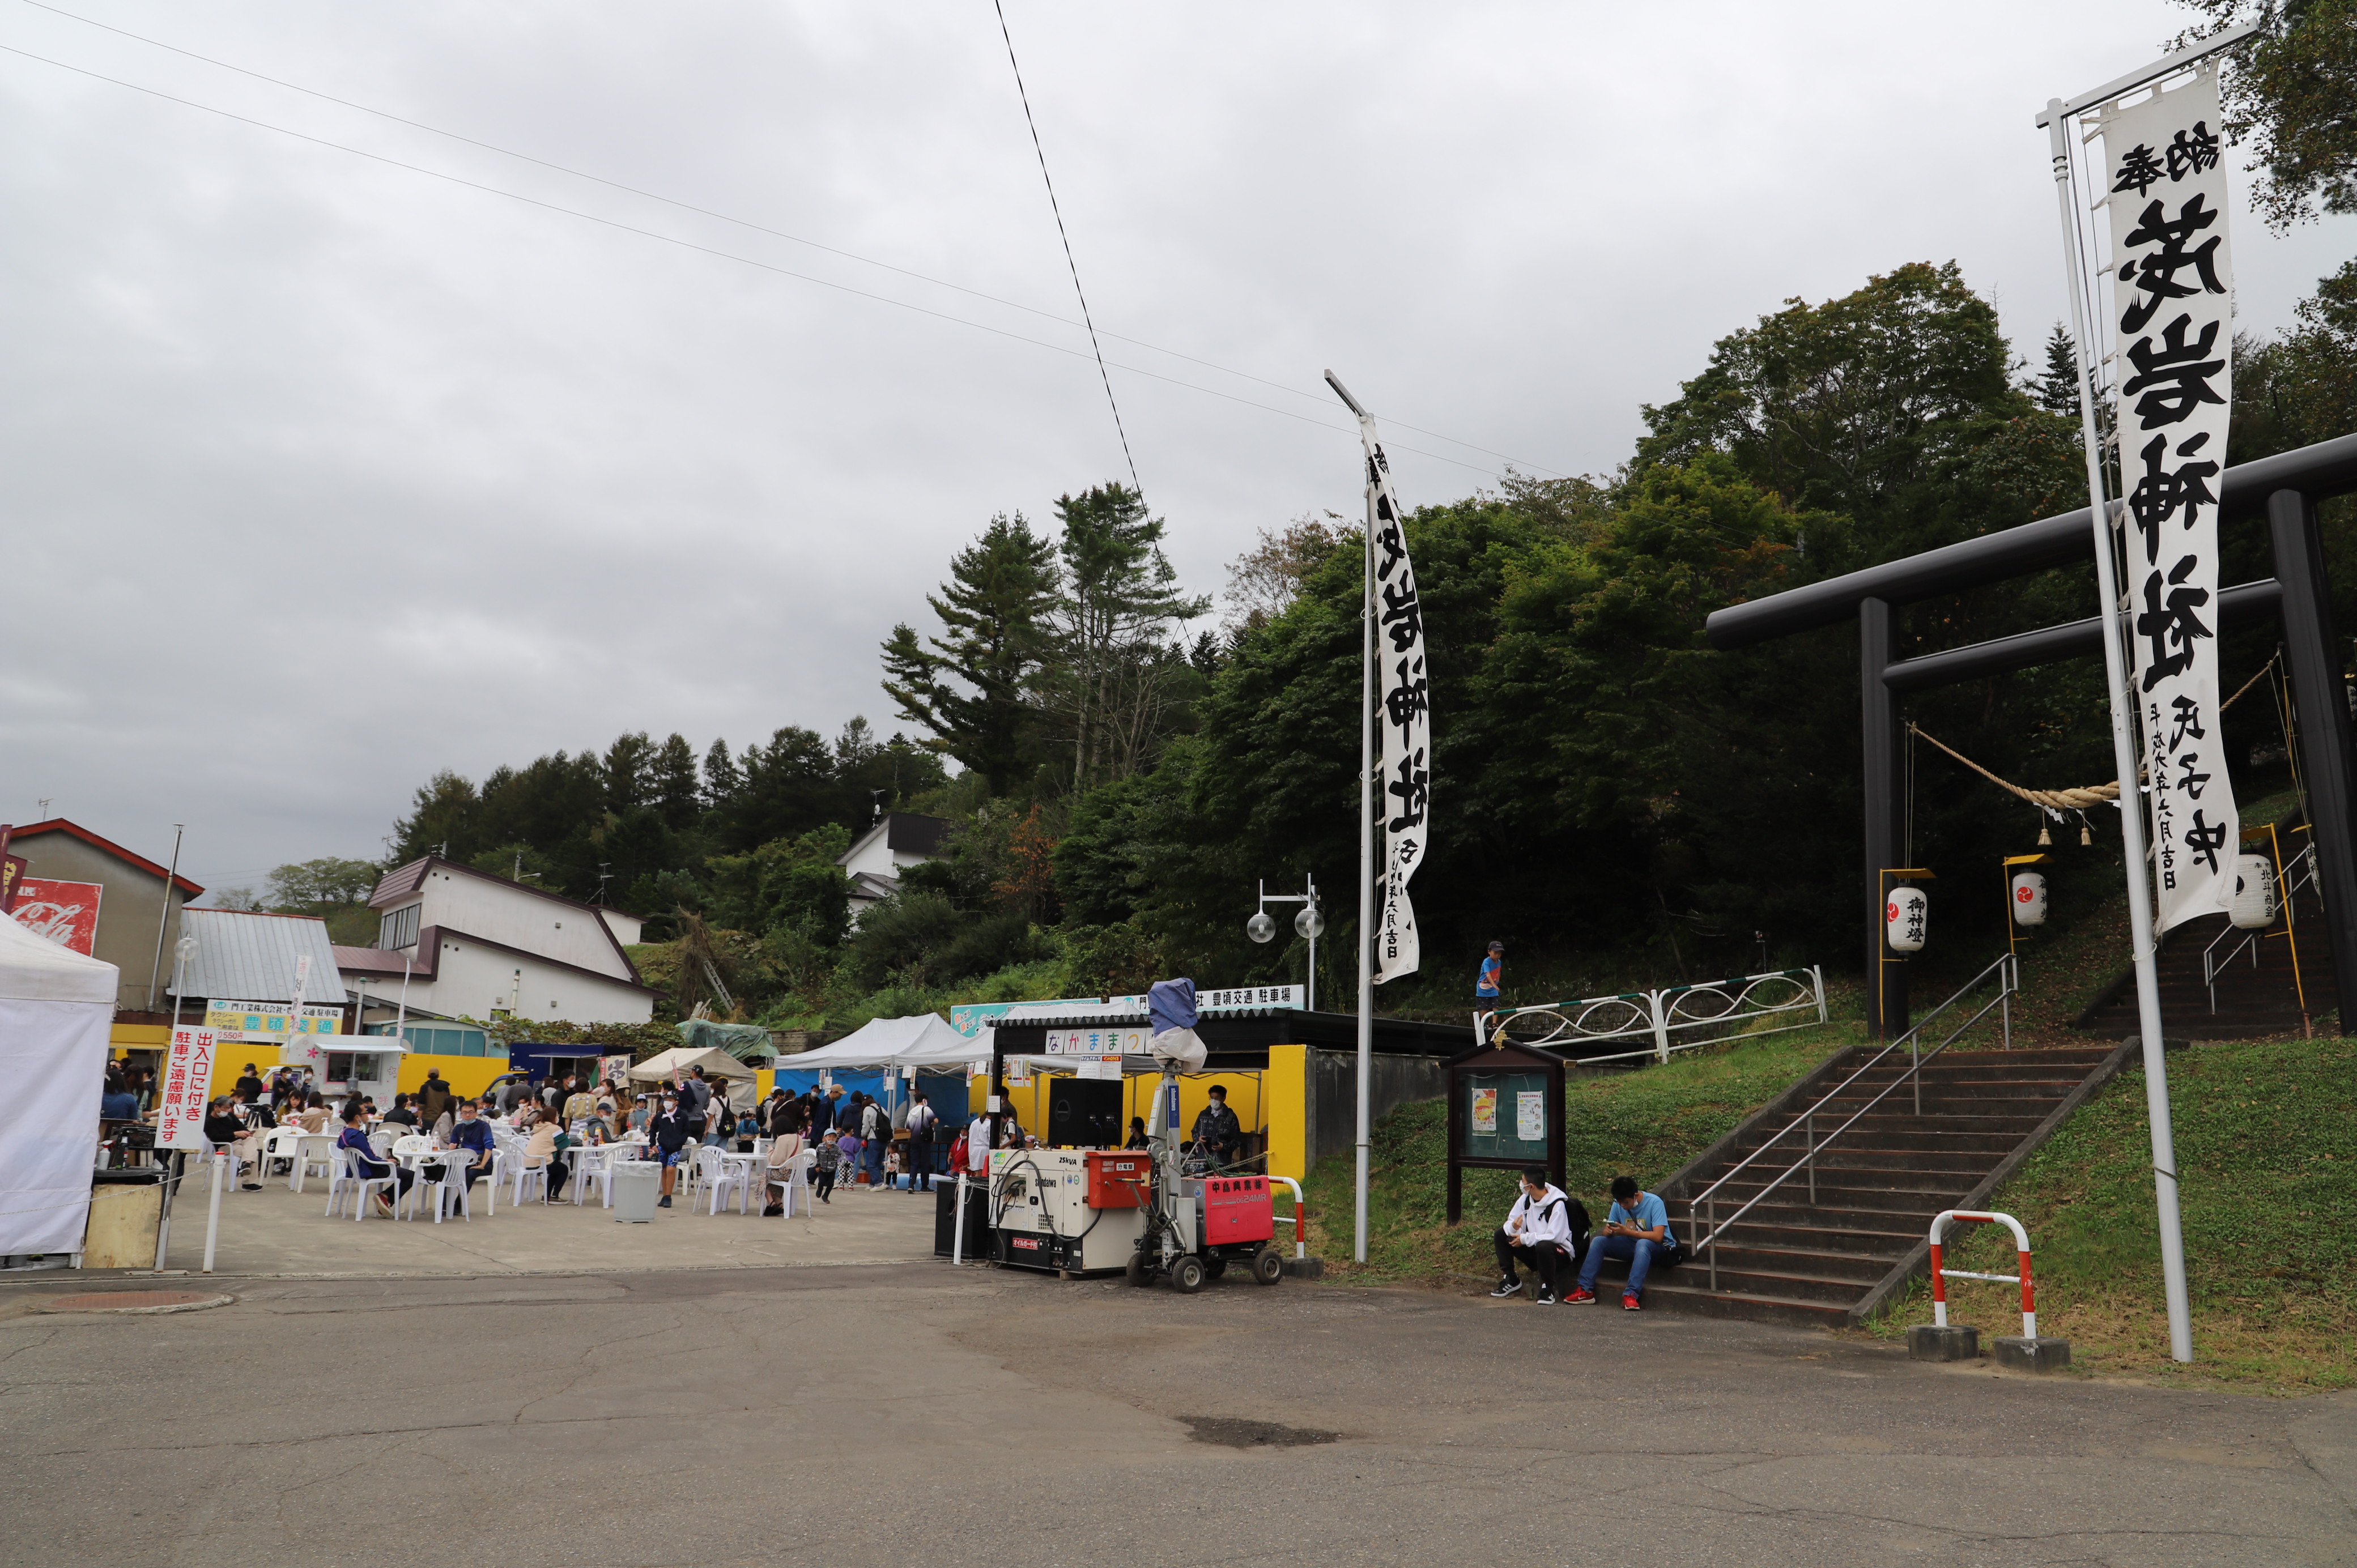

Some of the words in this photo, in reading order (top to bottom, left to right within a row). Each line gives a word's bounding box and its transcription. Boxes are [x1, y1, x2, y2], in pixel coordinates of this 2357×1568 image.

[2261, 870, 2273, 917] 北斗商会
[1212, 990, 1253, 1006] 豊頃交通
[1259, 987, 1291, 1003] 駐車場
[1049, 1032, 1154, 1051] なかままつ
[186, 1033, 212, 1121] 出入口に付き
[161, 1032, 192, 1142] 駐車ご遠慮願います
[1236, 1194, 1267, 1204] DG24MR
[1013, 1239, 1037, 1249] オイルガード付
